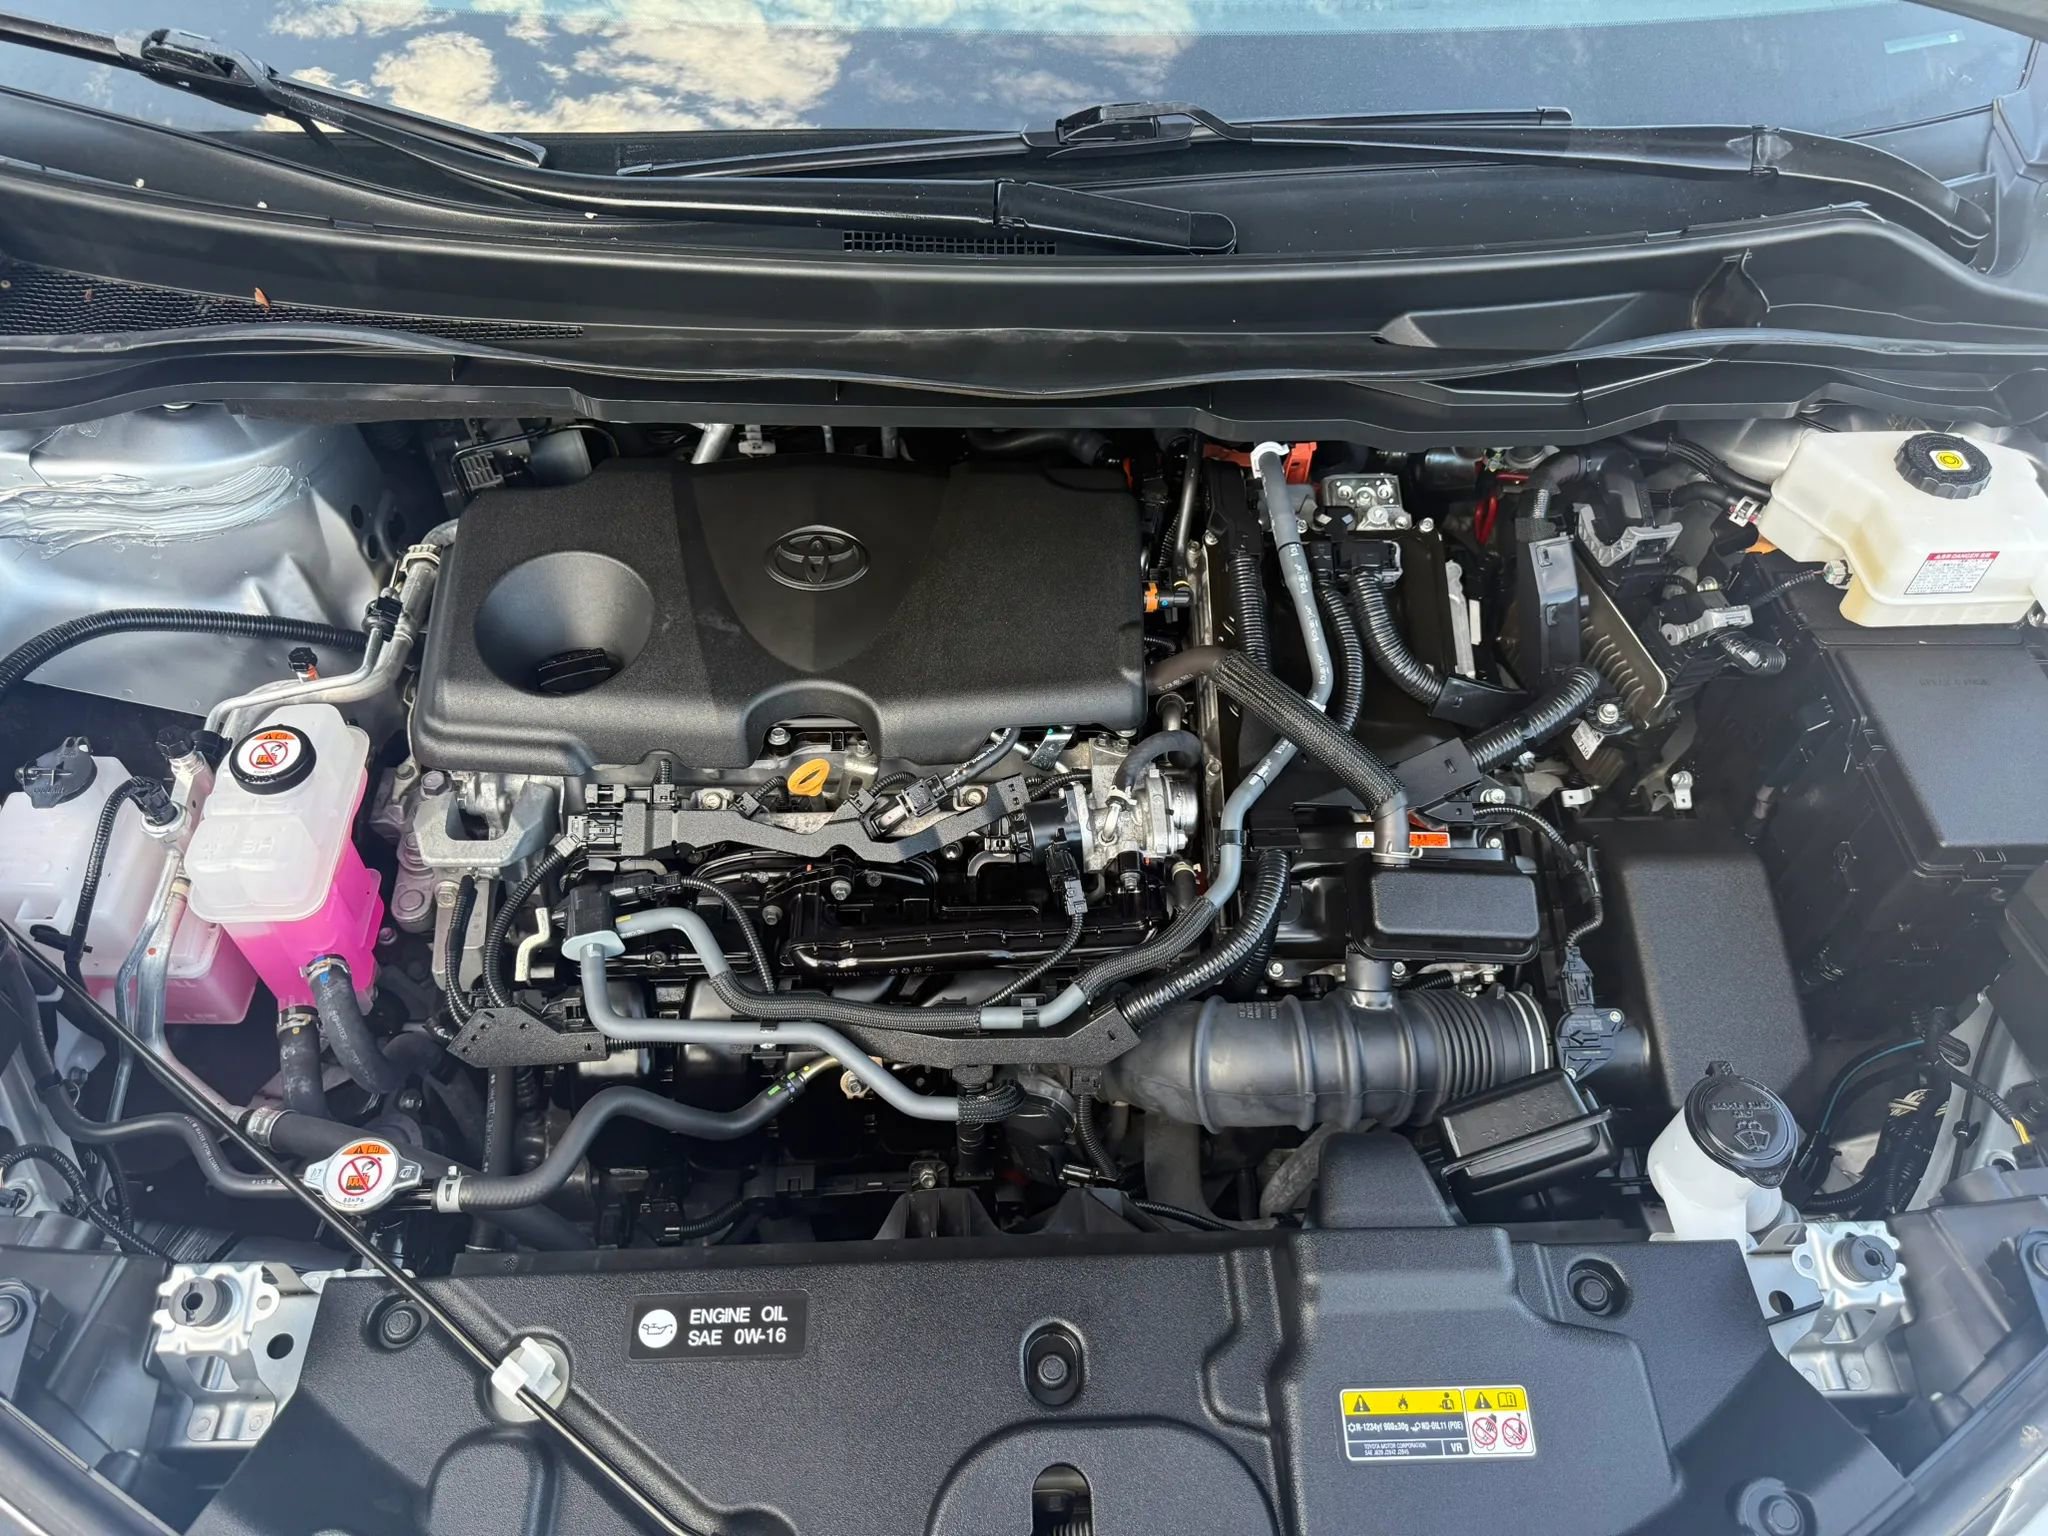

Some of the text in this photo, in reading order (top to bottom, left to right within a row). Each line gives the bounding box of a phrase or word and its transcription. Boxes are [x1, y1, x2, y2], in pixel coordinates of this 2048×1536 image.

[689, 1305, 788, 1325] ENGINE OIL
[687, 1327, 787, 1346] SAE 0W-16
[1450, 1442, 1464, 1452] VR
